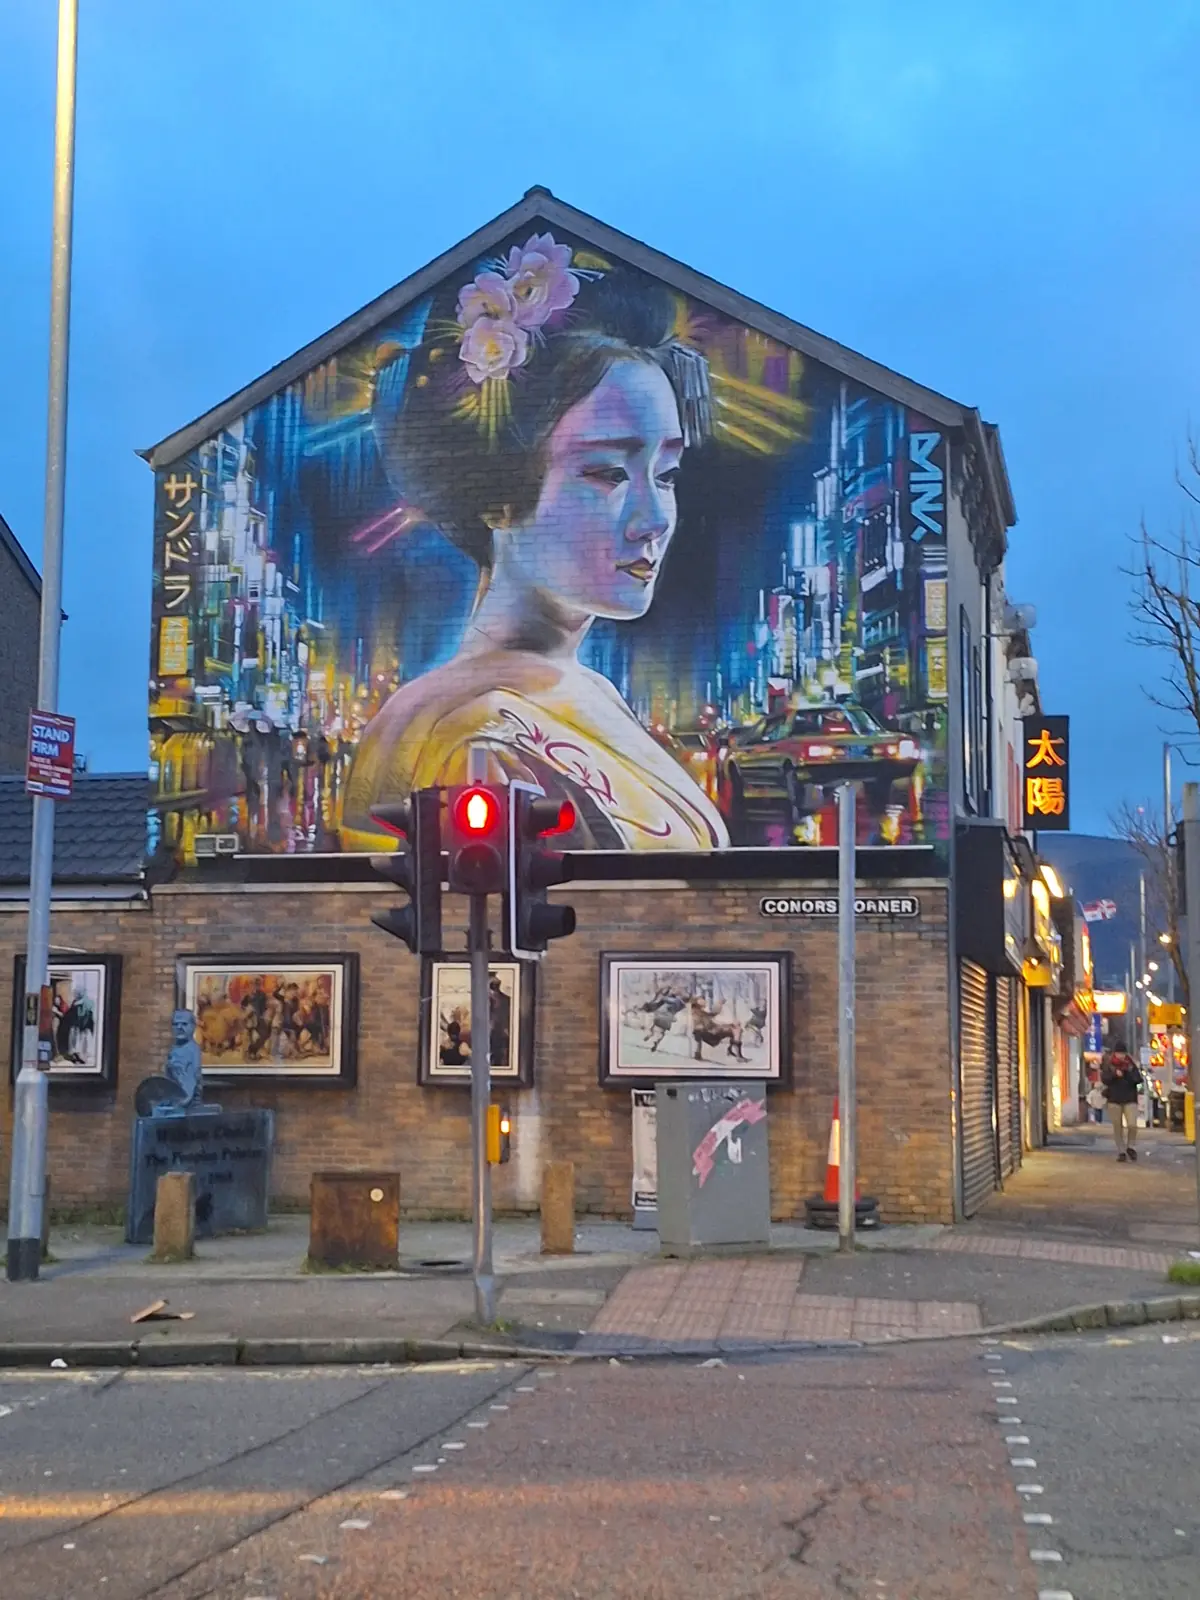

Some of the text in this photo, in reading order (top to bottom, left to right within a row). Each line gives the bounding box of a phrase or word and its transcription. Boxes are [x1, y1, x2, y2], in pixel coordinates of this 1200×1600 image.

[164, 473, 197, 609] サンドラ
[31, 724, 70, 743] STAND
[31, 740, 59, 757] FIRM
[1026, 729, 1066, 815] 太陽
[764, 899, 913, 913] CONORS ORNER
